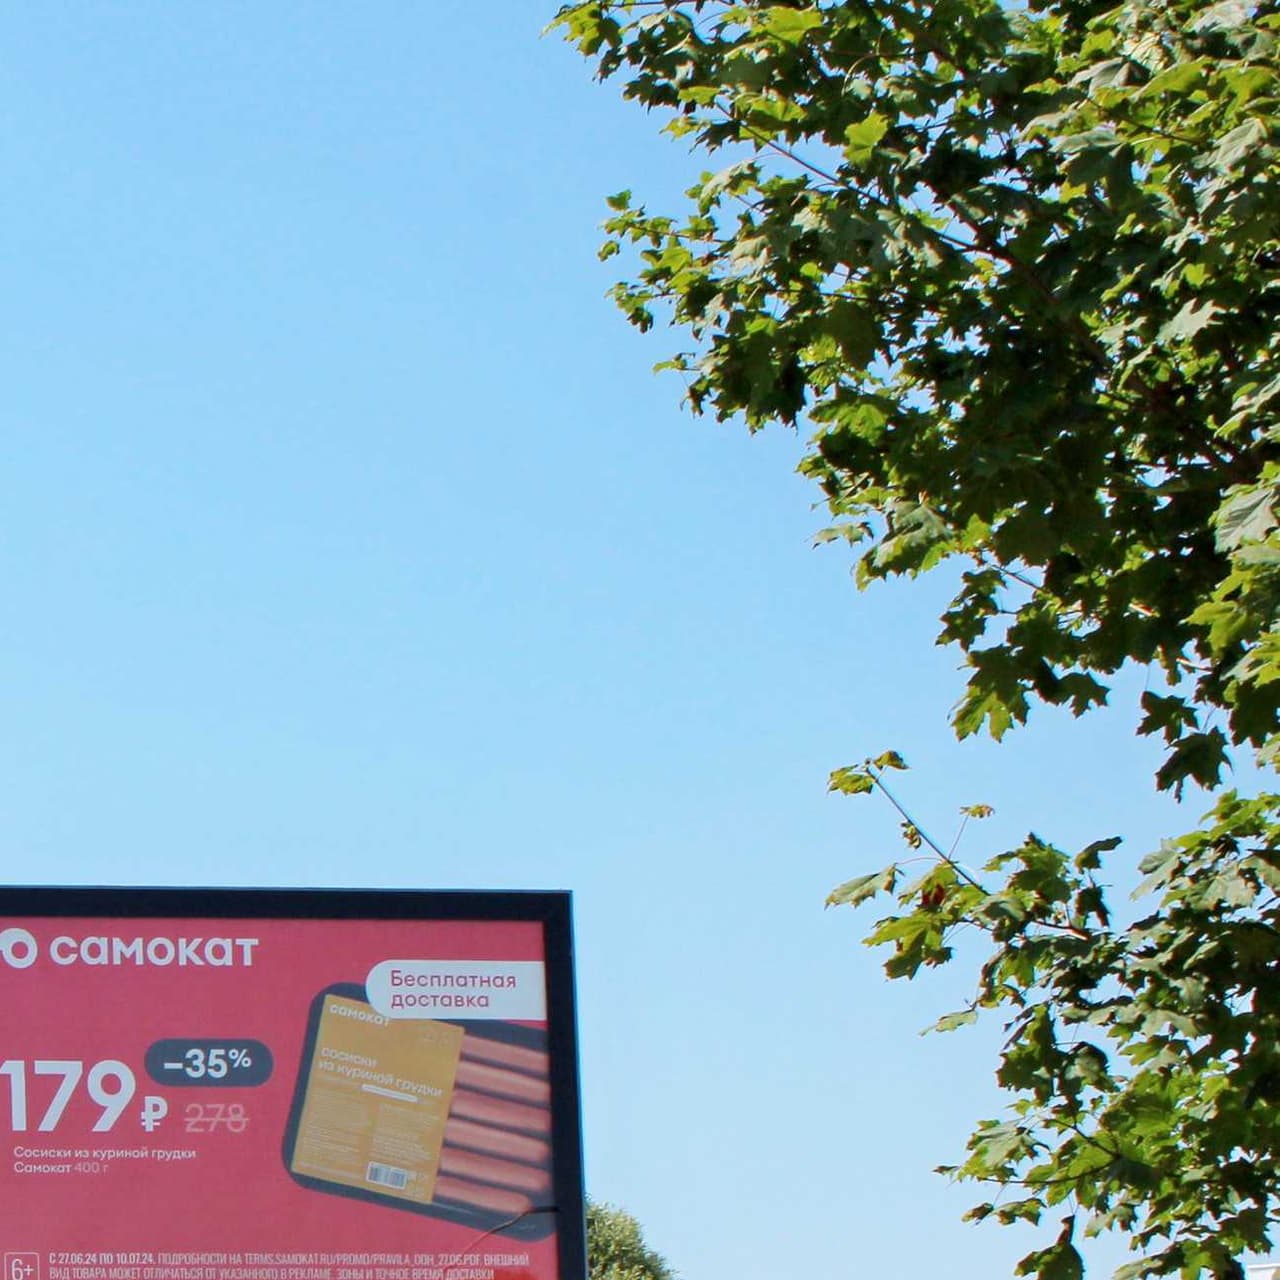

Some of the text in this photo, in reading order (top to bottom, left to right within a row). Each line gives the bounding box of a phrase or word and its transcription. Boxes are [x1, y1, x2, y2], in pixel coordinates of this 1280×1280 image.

[49, 936, 259, 967] самокат
[390, 970, 516, 988] Бесплатная
[390, 992, 490, 1009] доставка
[13, 1146, 196, 1162] Сосиски из куриной грудки
[13, 1161, 109, 1174] Самокат 400 г
[49, 1253, 56, 1264] С
[59, 1253, 97, 1264] 27.06.24
[99, 1253, 114, 1264] ПО
[229, 1253, 242, 1264] НА
[49, 1268, 70, 1279] ВИД
[72, 1268, 107, 1279] ТОВАРА
[109, 1268, 141, 1279] МОЖЕТ
[205, 1268, 217, 1280] ОТ
